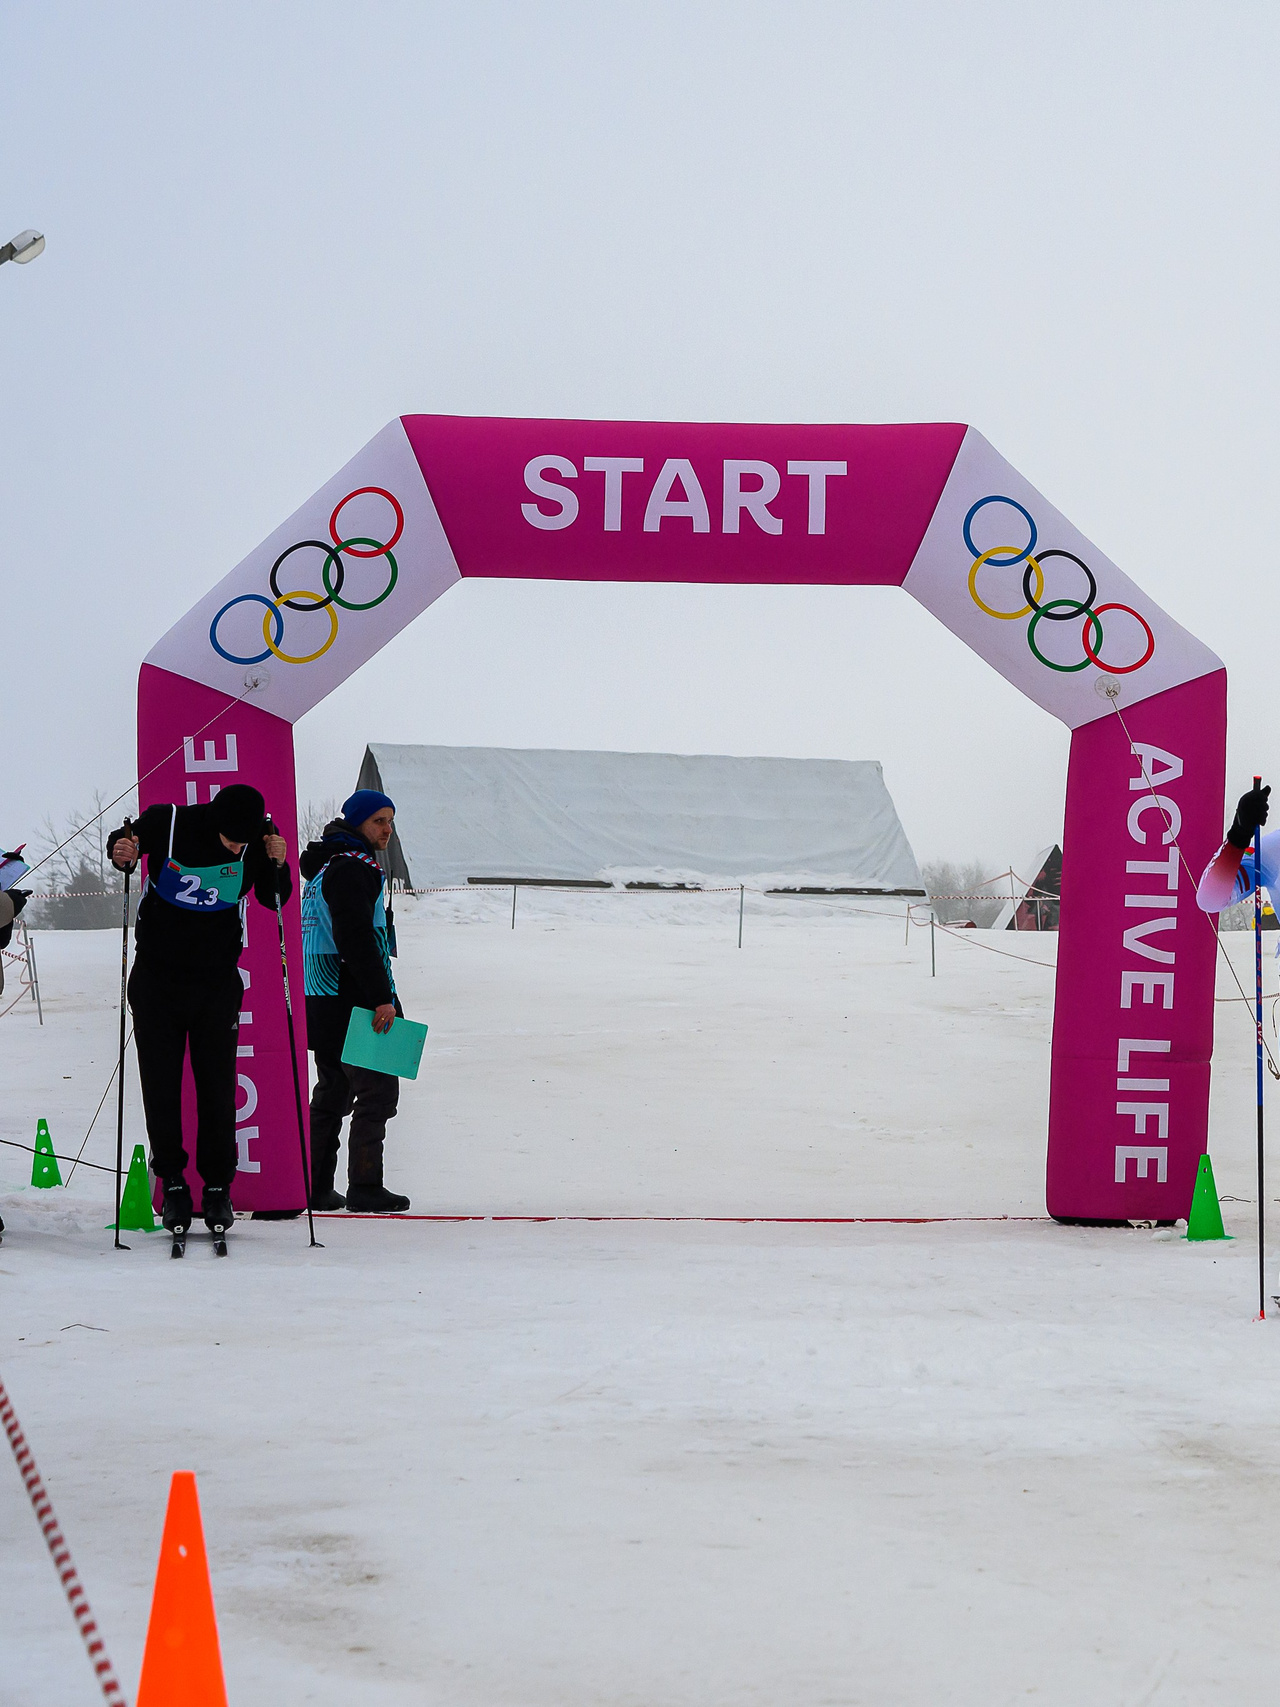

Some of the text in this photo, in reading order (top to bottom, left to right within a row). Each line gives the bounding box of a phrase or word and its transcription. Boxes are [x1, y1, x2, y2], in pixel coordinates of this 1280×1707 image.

[520, 454, 848, 537] START
[175, 874, 219, 906] 2.3
[1115, 741, 1184, 1184] ACTIVE LIFE
